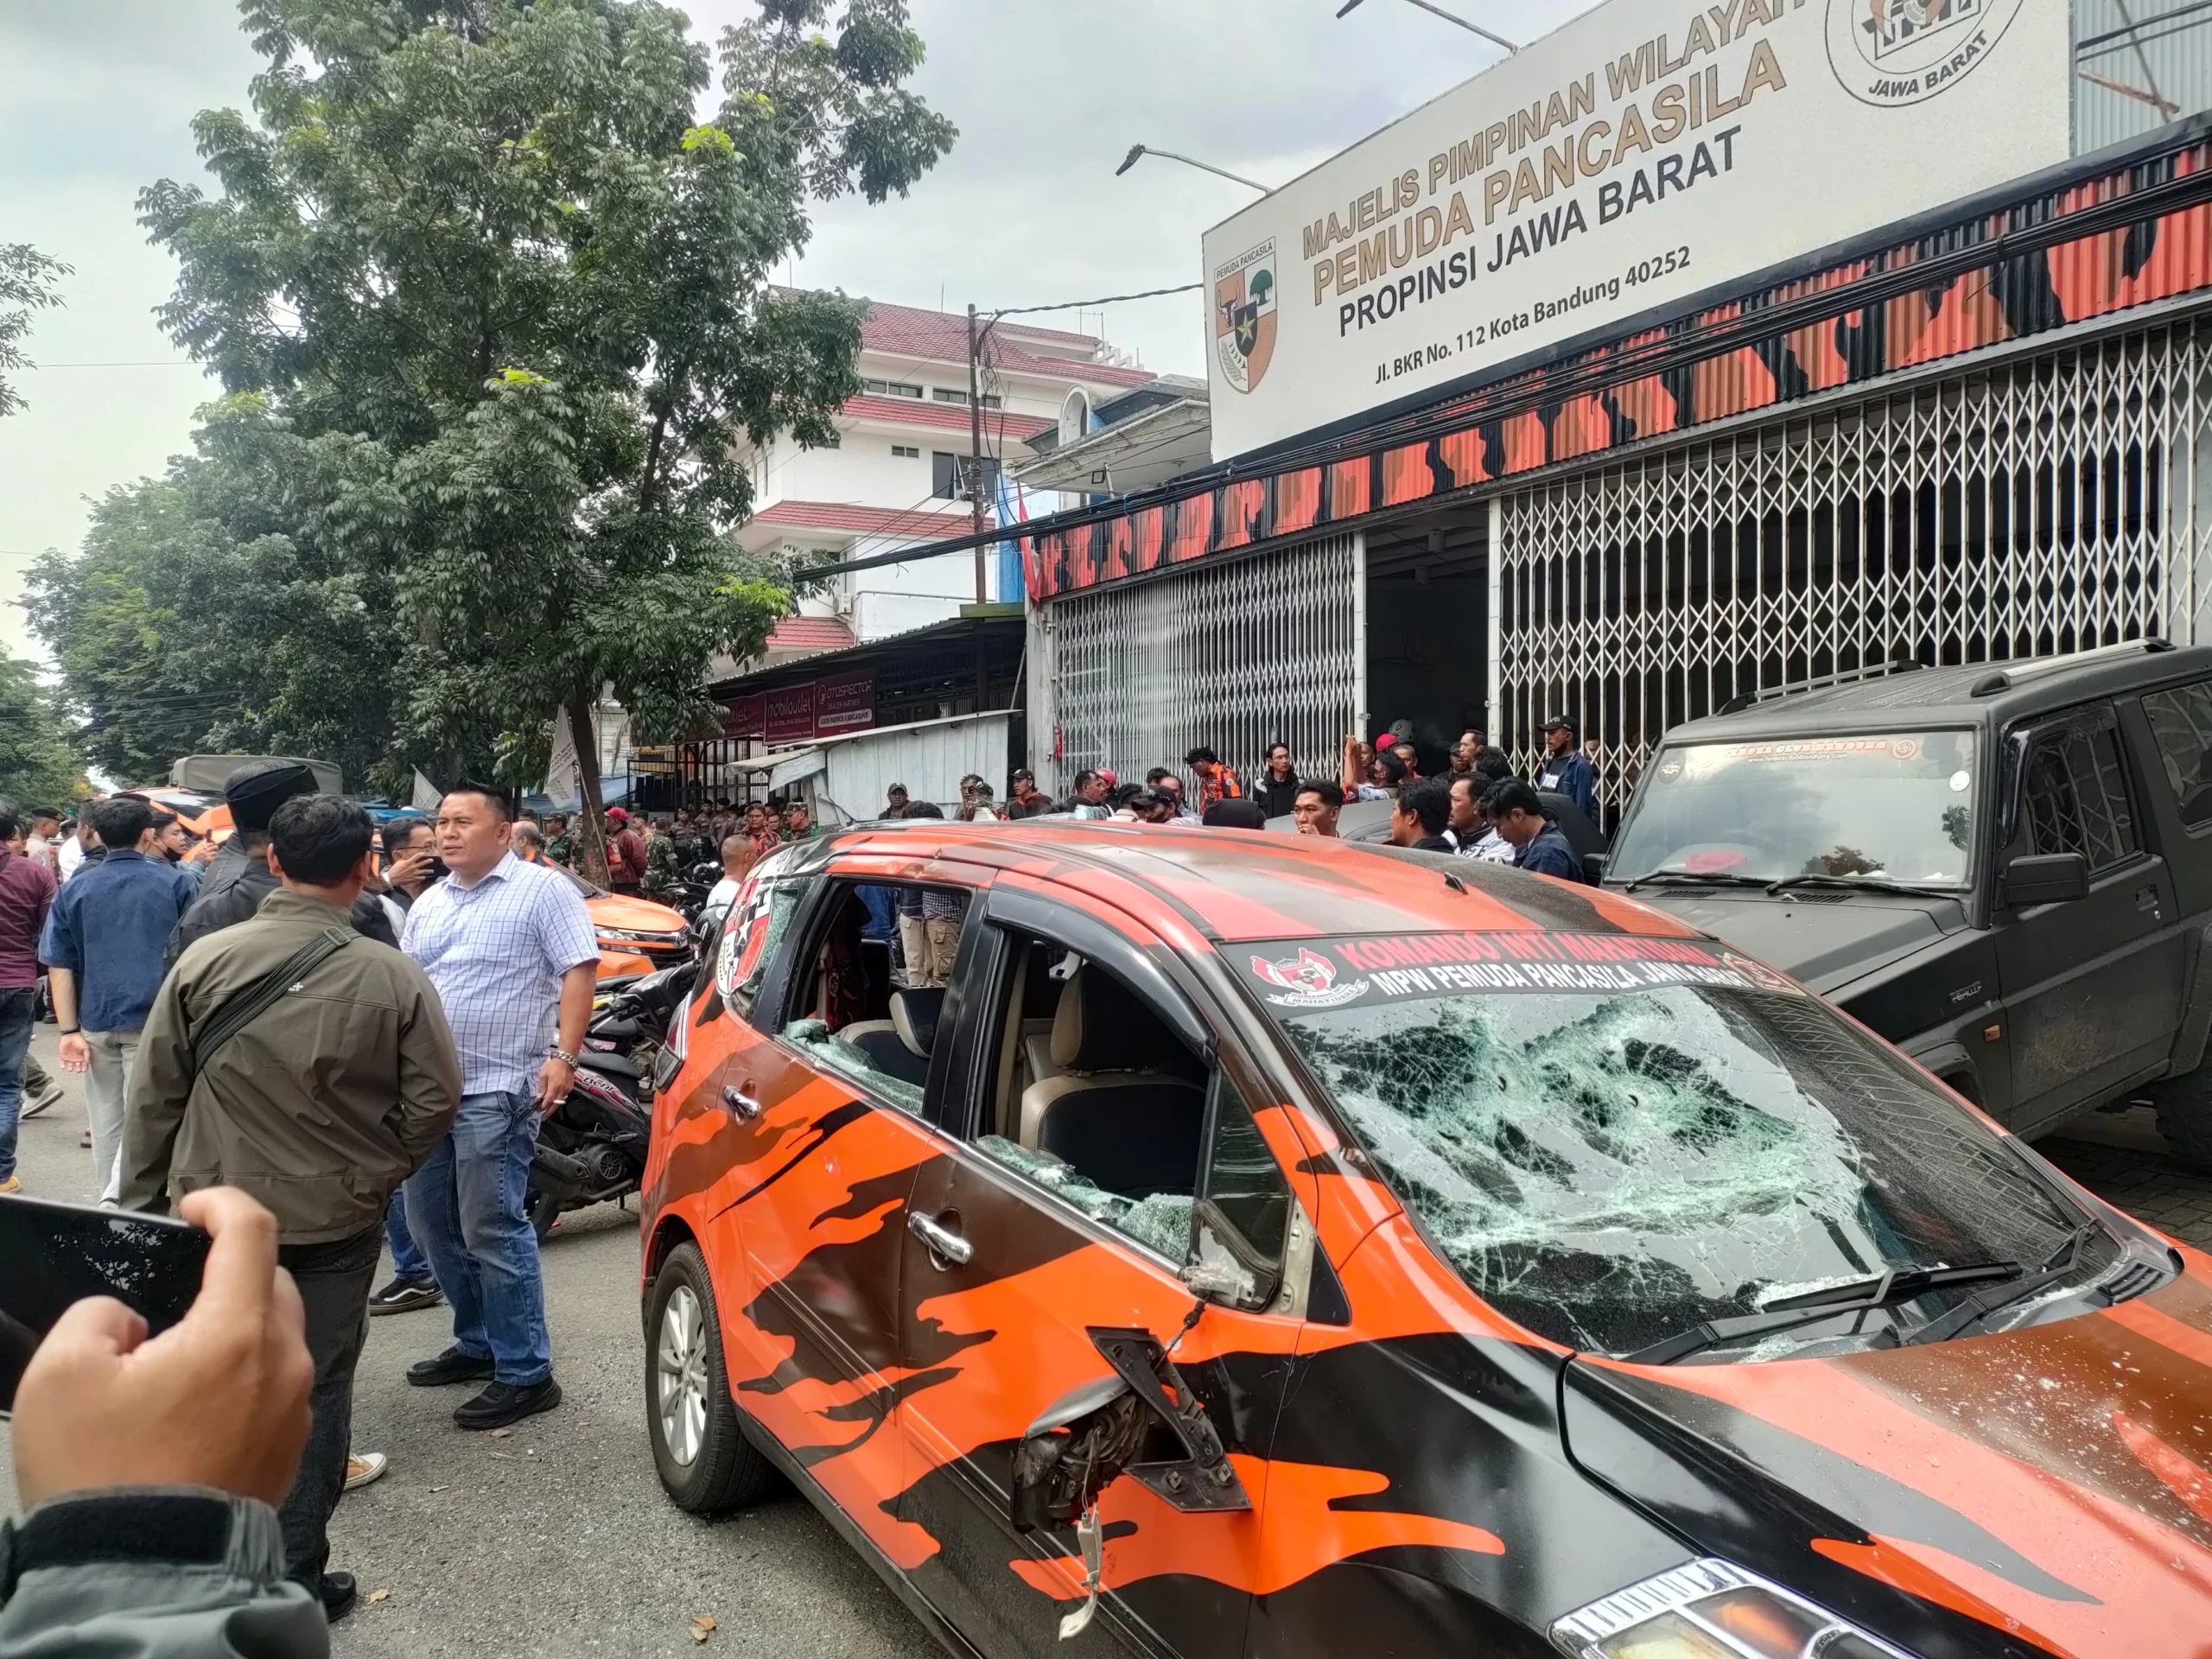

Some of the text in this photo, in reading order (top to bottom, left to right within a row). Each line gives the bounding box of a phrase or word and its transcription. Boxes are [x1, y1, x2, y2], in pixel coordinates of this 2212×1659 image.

[1869, 29, 1987, 97] JAWA BARAT
[1302, 168, 1420, 260] MAJELIS
[1428, 71, 1595, 195] PIMPINAN
[1313, 37, 1787, 306] PEMUDA PANCASILA
[1217, 241, 1273, 279] PEMUDA PANCASILA
[1339, 124, 1741, 337] PROPINSI JAWA BARAT
[1375, 245, 1691, 385] Jl. BKR No. 112 Kota Bandung 40252
[826, 680, 873, 699] OTOSPECTOR
[1333, 931, 1502, 971] KOMANDO
[1490, 931, 1567, 961] INTI
[1369, 967, 1437, 995] MPW
[1427, 963, 1533, 988] PEMUDA
[1521, 963, 1646, 989] PANCASILA
[1636, 961, 1698, 983] JAWA
